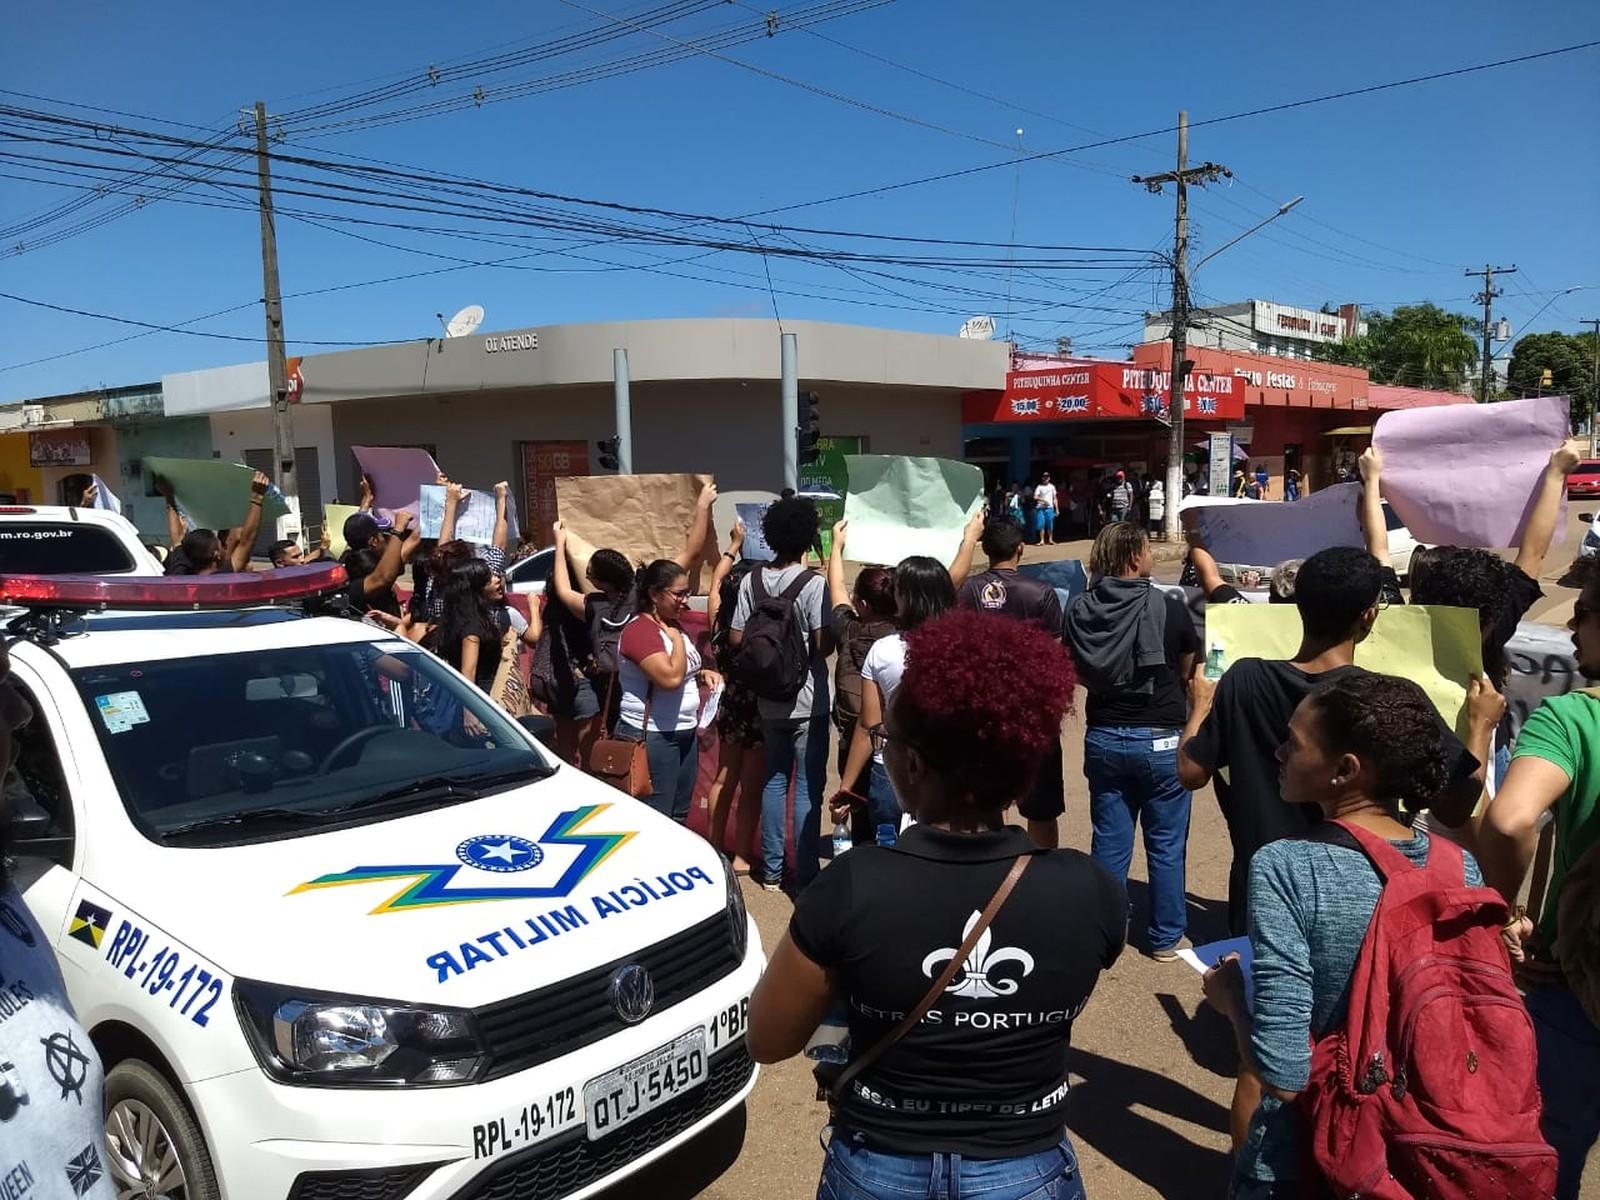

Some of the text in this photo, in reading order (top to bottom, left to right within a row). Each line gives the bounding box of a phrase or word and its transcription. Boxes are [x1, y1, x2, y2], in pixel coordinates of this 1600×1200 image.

[499, 333, 538, 351] ATENDE
[1198, 374, 1233, 394] CENTER
[106, 919, 223, 1028] RPL-19-172
[0, 979, 34, 1023] ULES
